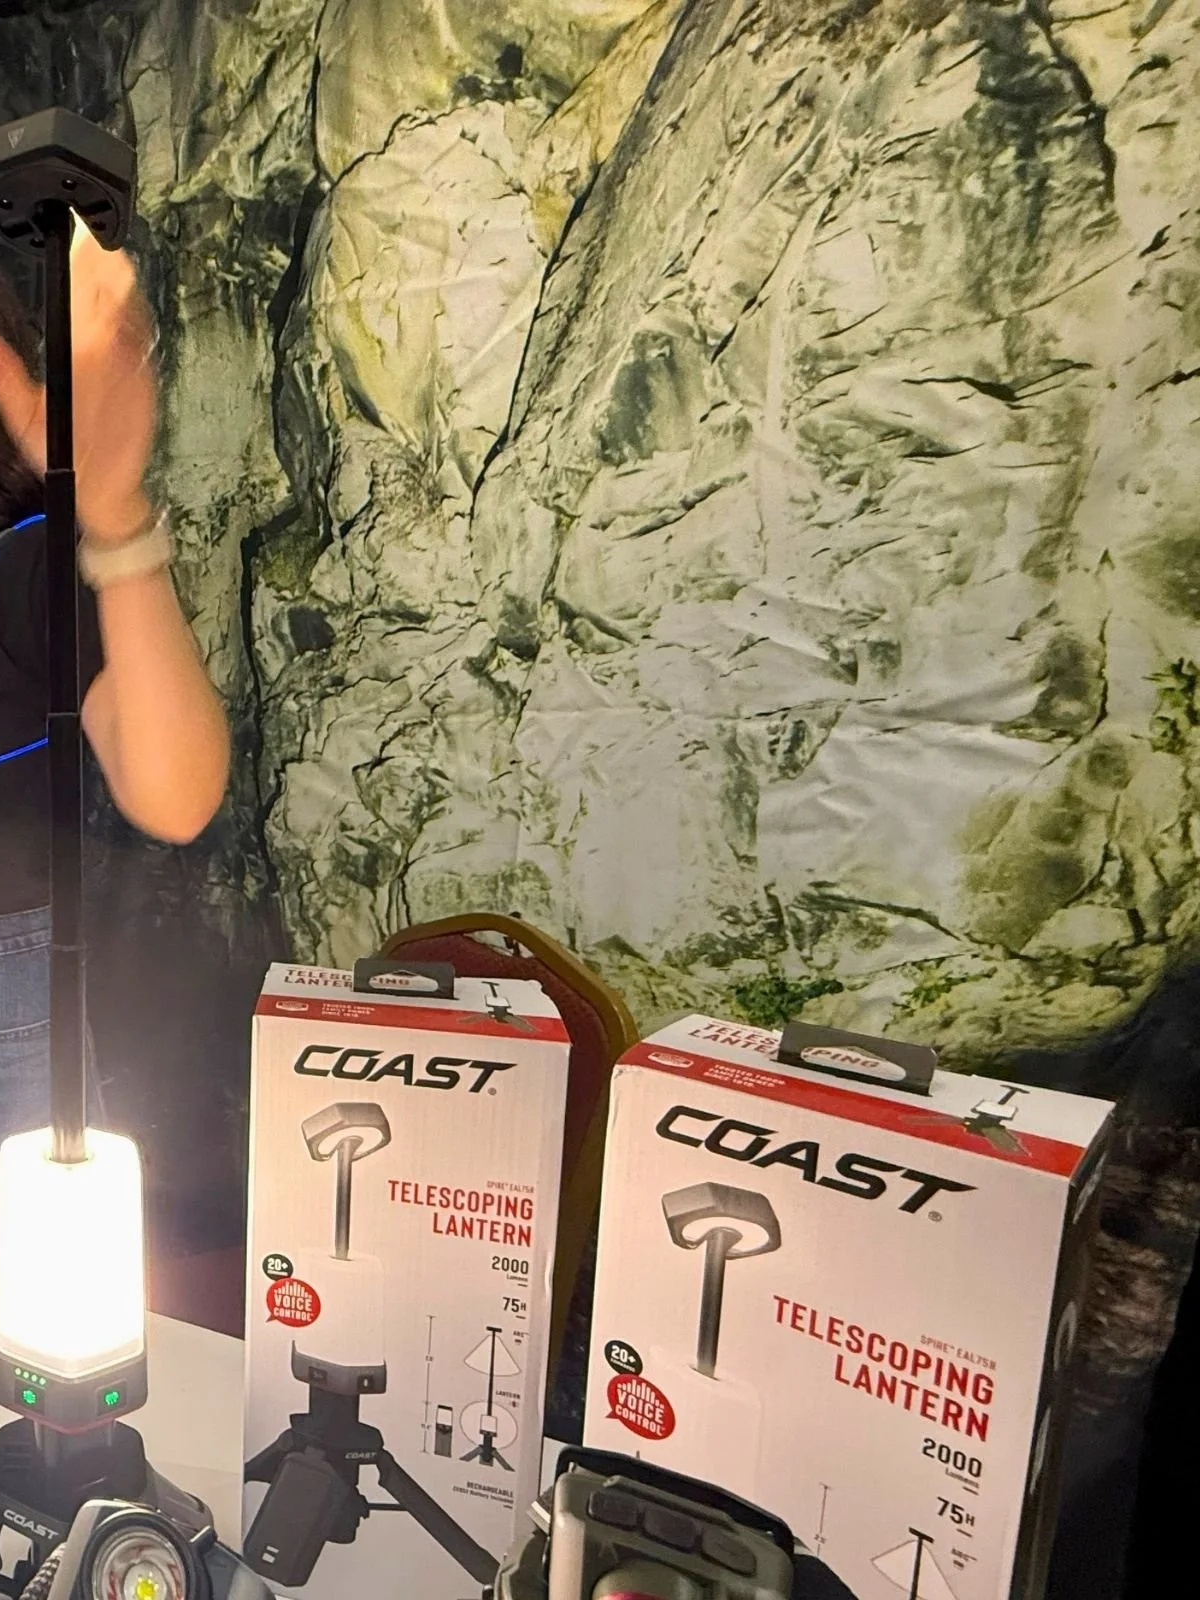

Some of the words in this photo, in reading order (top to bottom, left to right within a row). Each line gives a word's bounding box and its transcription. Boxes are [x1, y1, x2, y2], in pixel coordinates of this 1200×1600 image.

[293, 1045, 518, 1093] COAST
[655, 1105, 979, 1214] COAST
[388, 1180, 533, 1220] TELESCOPING
[433, 1212, 532, 1247] LANTERN
[267, 1258, 288, 1271] 20+
[491, 1256, 529, 1275] 2000
[274, 1293, 312, 1311] VOICE
[611, 1345, 636, 1363] 20+
[773, 1295, 994, 1406] TELESCOPING
[617, 1388, 664, 1424] VOICE
[834, 1354, 990, 1443] LANTERN
[615, 1404, 664, 1436] CONTROL
[345, 1451, 378, 1460] COAST
[922, 1438, 982, 1478] 2000
[3, 1509, 59, 1540] COAST
